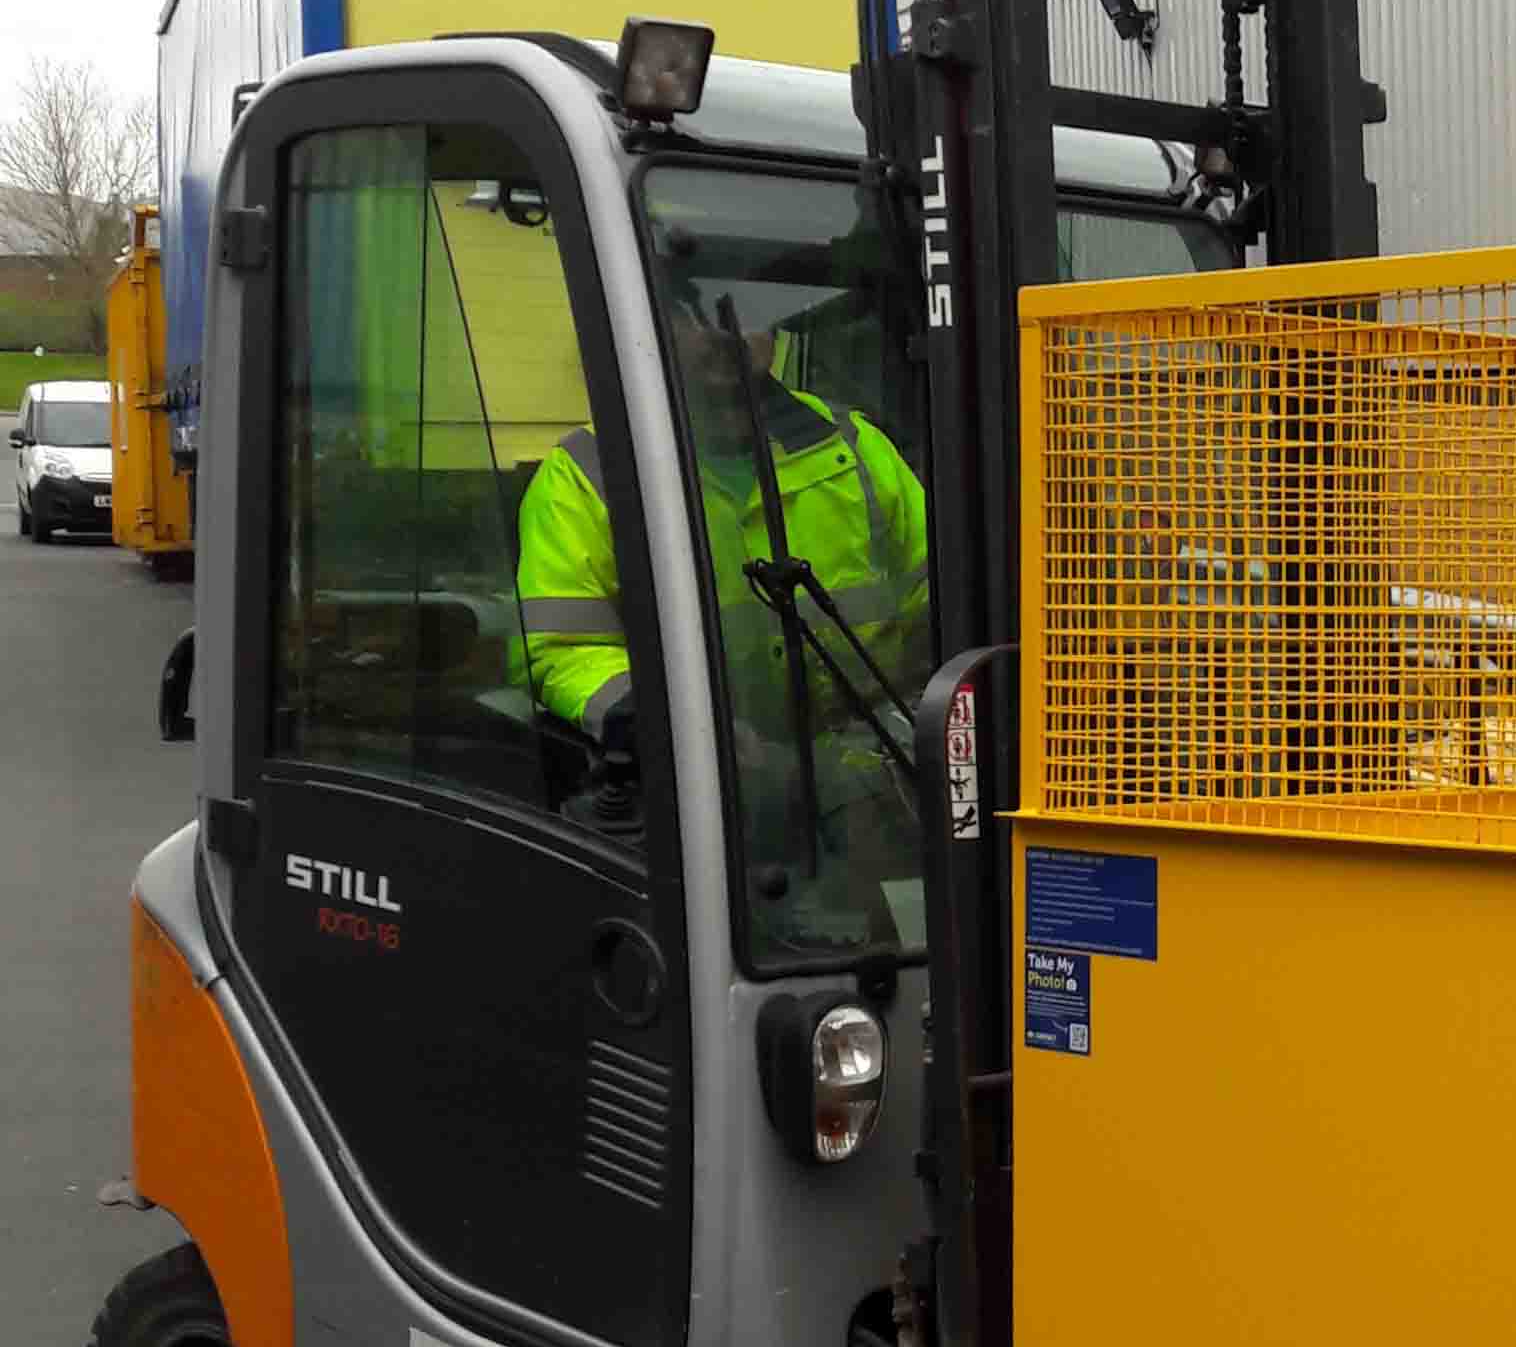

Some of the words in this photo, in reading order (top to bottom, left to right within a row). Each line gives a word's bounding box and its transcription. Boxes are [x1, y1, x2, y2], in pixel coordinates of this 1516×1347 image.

[921, 134, 953, 328] STILL
[285, 852, 401, 914] STILL
[1027, 953, 1055, 971] Take
[1056, 956, 1075, 976] My
